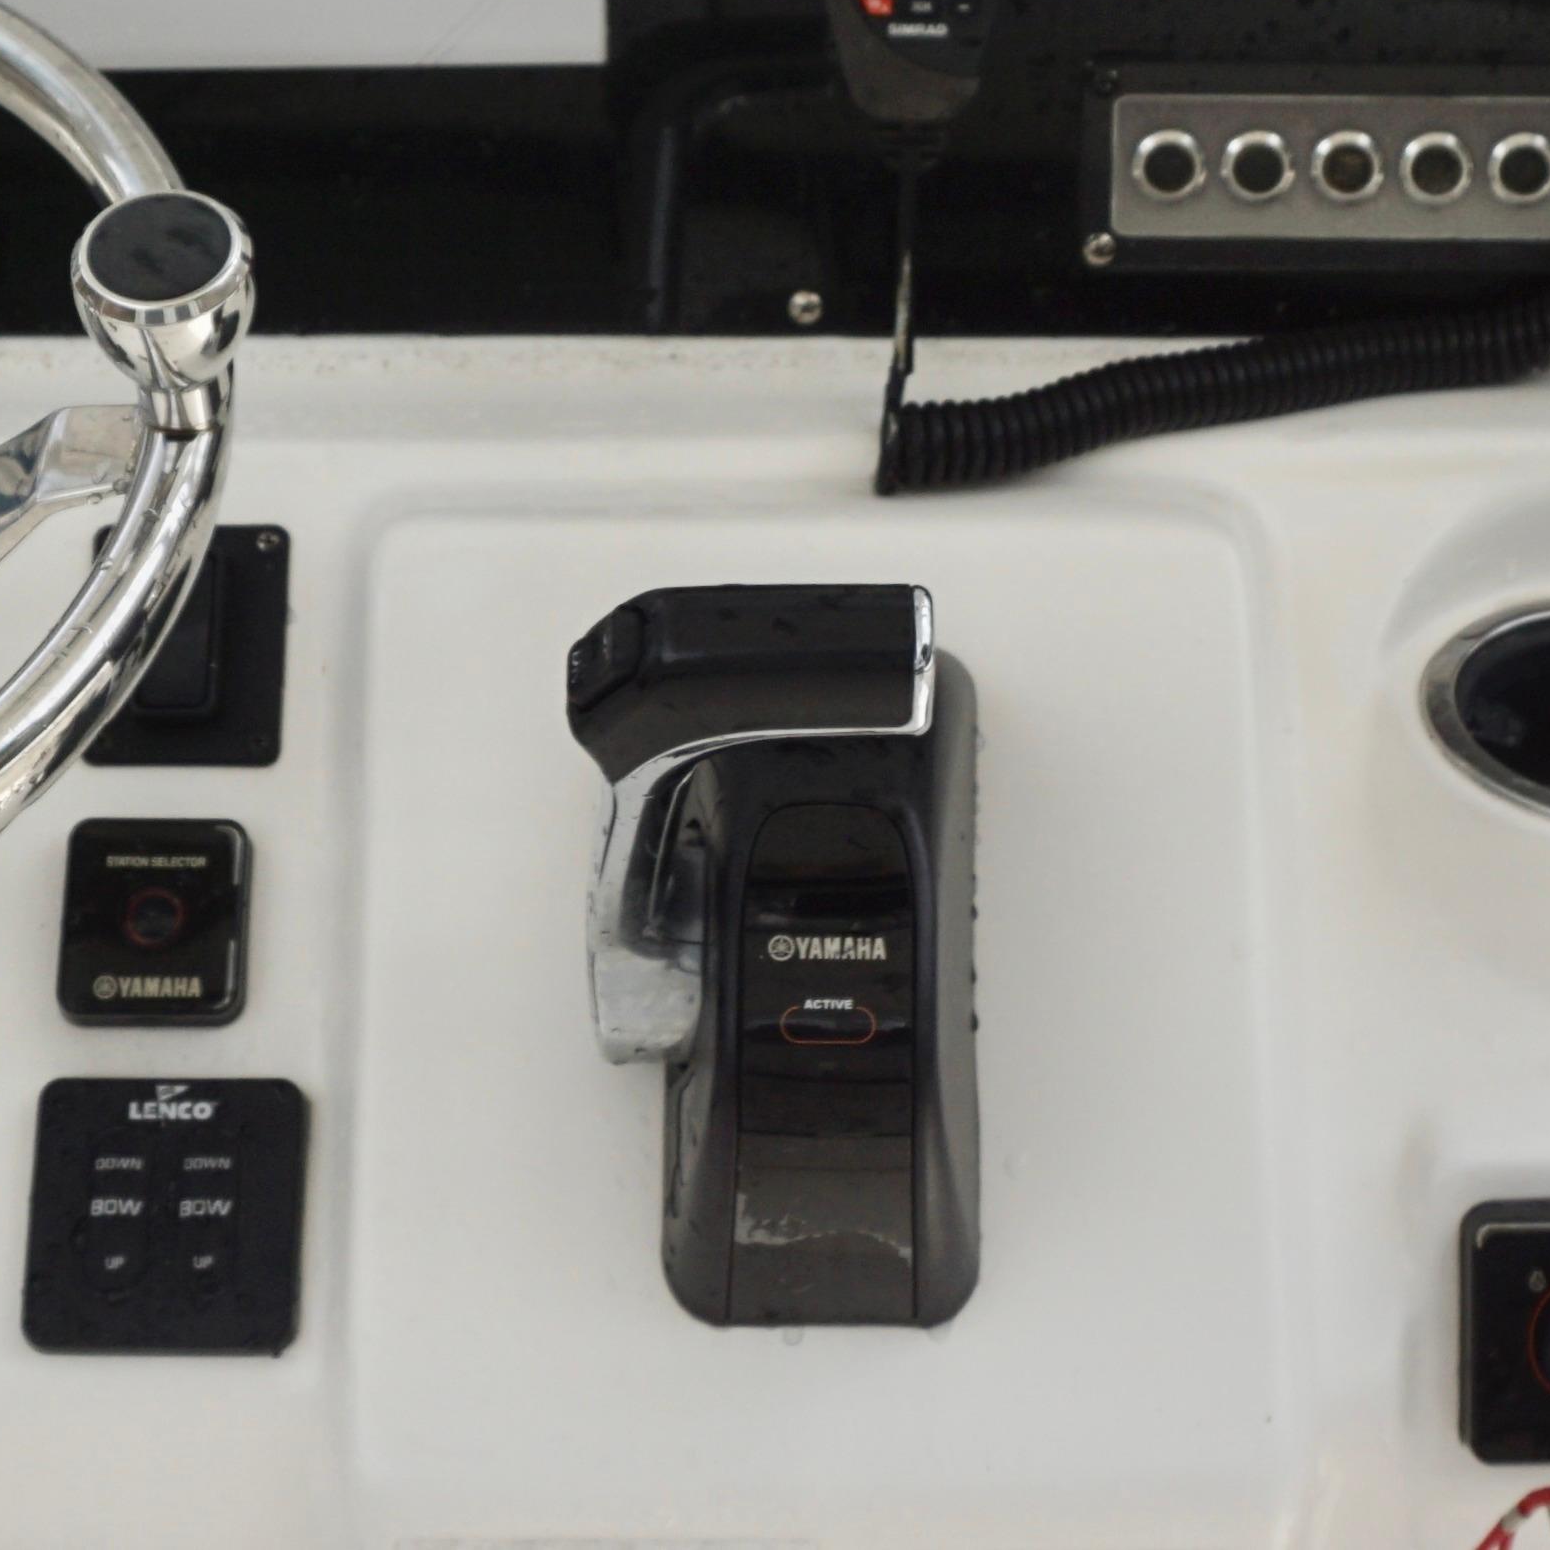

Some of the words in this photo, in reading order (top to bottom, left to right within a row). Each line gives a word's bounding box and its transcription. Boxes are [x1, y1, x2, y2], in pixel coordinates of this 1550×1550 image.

[888, 22, 948, 37] SIMRAD
[106, 855, 149, 868] STATION
[151, 855, 206, 868] SELECTOR
[796, 937, 887, 960] YAMAHA
[118, 976, 201, 998] YAMAHA
[803, 999, 854, 1010] ACTIVE
[128, 1101, 214, 1120] LENCO
[90, 1199, 143, 1216] BOW
[179, 1199, 232, 1217] BOW
[105, 1256, 126, 1269] UP
[193, 1256, 214, 1269] UP
